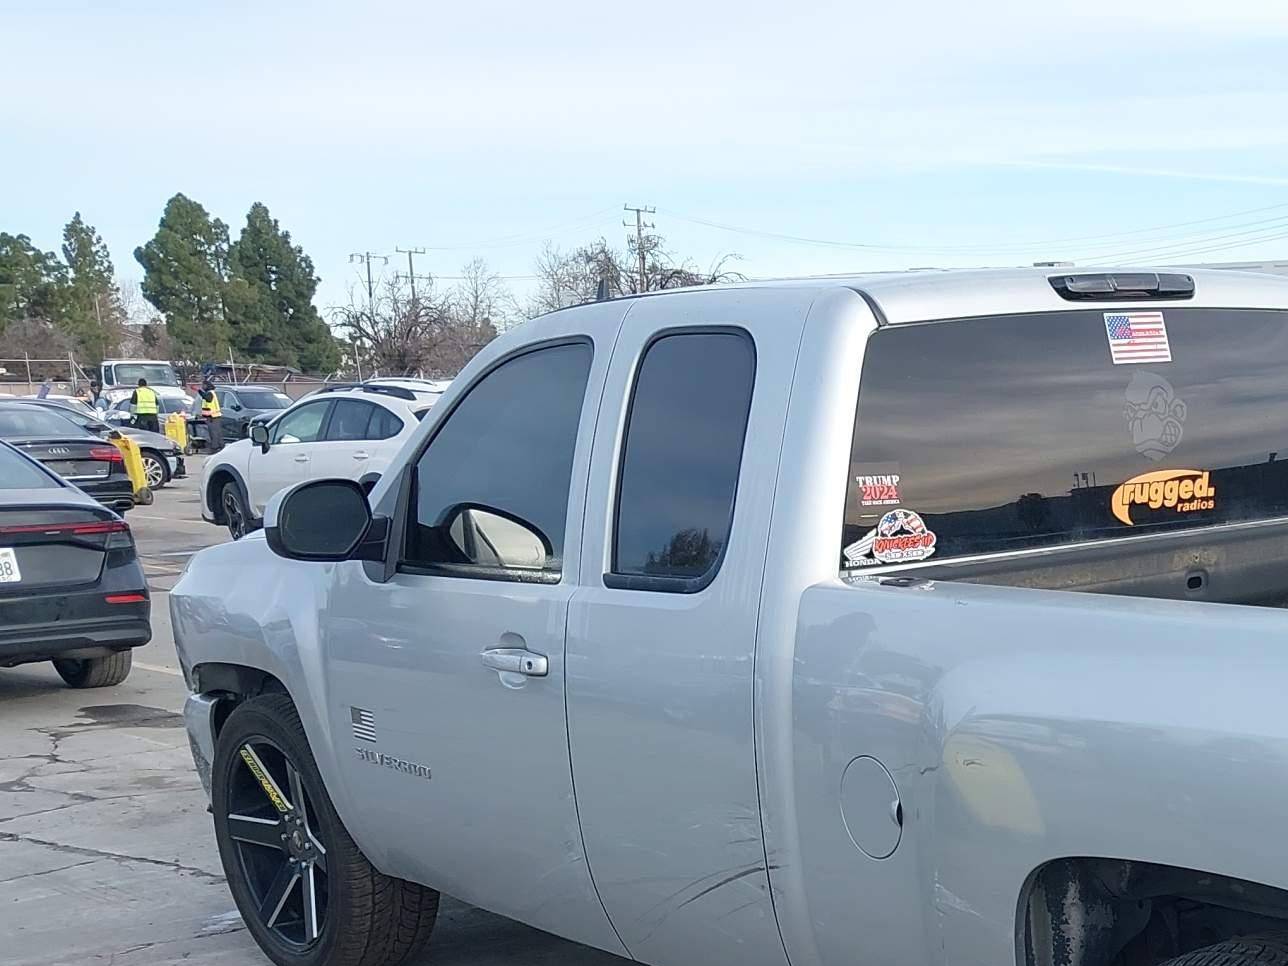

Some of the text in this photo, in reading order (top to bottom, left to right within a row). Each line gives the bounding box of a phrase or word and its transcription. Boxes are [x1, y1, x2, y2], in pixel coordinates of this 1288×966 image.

[856, 475, 899, 488] TRUMP
[862, 485, 898, 500] 2024
[1177, 499, 1215, 512] radios
[845, 558, 882, 567] HONDA
